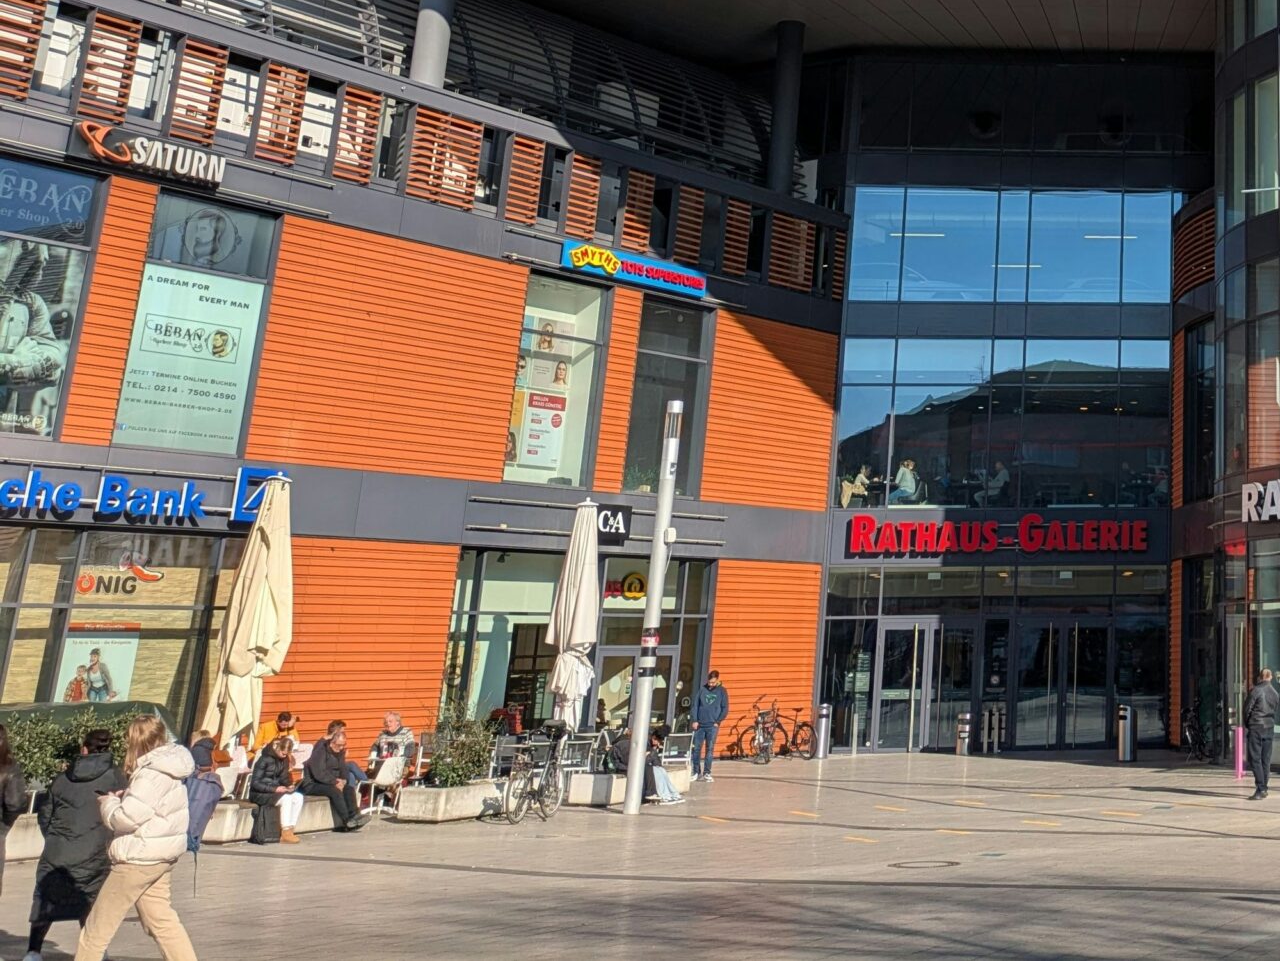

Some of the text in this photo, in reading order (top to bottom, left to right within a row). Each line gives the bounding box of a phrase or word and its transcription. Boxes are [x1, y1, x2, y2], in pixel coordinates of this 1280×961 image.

[132, 137, 226, 182] SATURN
[17, 208, 50, 226] Shop
[573, 248, 620, 273] SMYTHS
[620, 259, 645, 278] TOYS
[147, 274, 210, 291] A DREAM FOR
[198, 295, 250, 310] EVERY MAN
[153, 322, 204, 342] BEBAN
[151, 371, 182, 380] TERMINE
[183, 375, 208, 384] ONLINE
[126, 380, 151, 390] TEL.:
[153, 384, 178, 393] 0214
[187, 388, 211, 397] 7500
[213, 392, 237, 400] 4590
[0, 469, 206, 518] che Bank
[598, 510, 626, 533] C&A
[62, 569, 137, 595] ÖNIG
